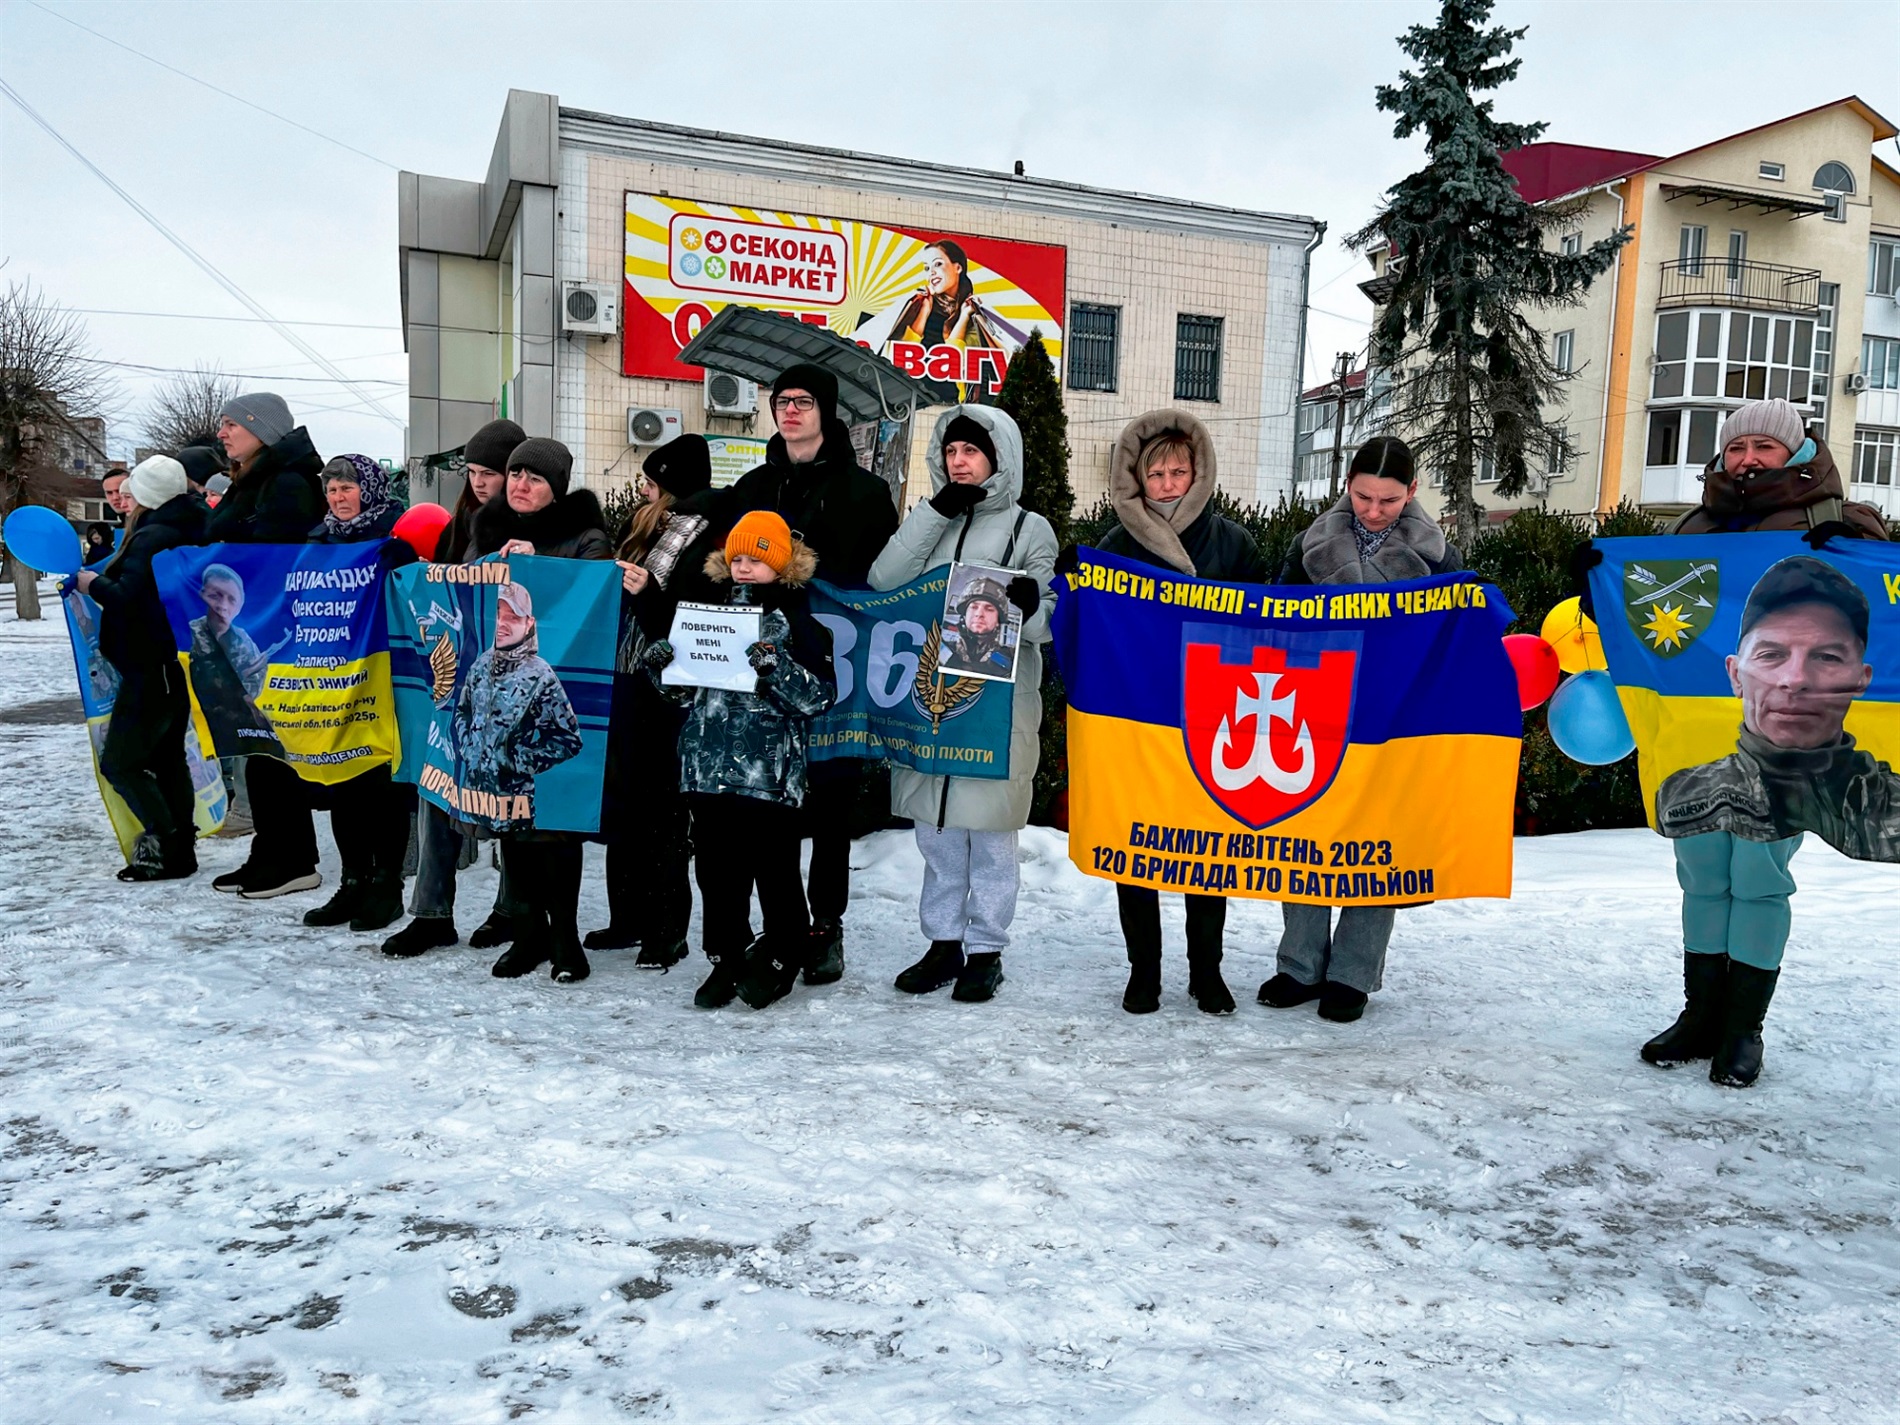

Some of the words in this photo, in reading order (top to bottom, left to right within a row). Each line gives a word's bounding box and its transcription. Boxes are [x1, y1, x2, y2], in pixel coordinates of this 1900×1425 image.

[730, 233, 836, 269] СЕКОНД
[729, 260, 837, 292] МАРКЕТ
[426, 564, 445, 583] 36
[1159, 581, 1245, 615] ЗНИКЛІ
[1261, 594, 1325, 619] ГЕРОЇ
[1329, 593, 1392, 620] ЯКИХ
[681, 621, 736, 634] ПОВЕРНІТЬ
[696, 638, 721, 648] МЕНІ
[690, 652, 730, 663] БАТЬКА
[938, 746, 994, 764] ПІХОТИ
[461, 787, 531, 821] ПІХОТА
[1129, 821, 1223, 857] БАХМУТ
[1226, 833, 1323, 866] КВІТЕНЬ
[1330, 840, 1392, 867] 2023
[1092, 846, 1126, 875] 120
[1131, 853, 1237, 892] БРИГАДА
[1243, 865, 1282, 894] 170
[1289, 866, 1434, 899] БАТАЛЬЙОН
